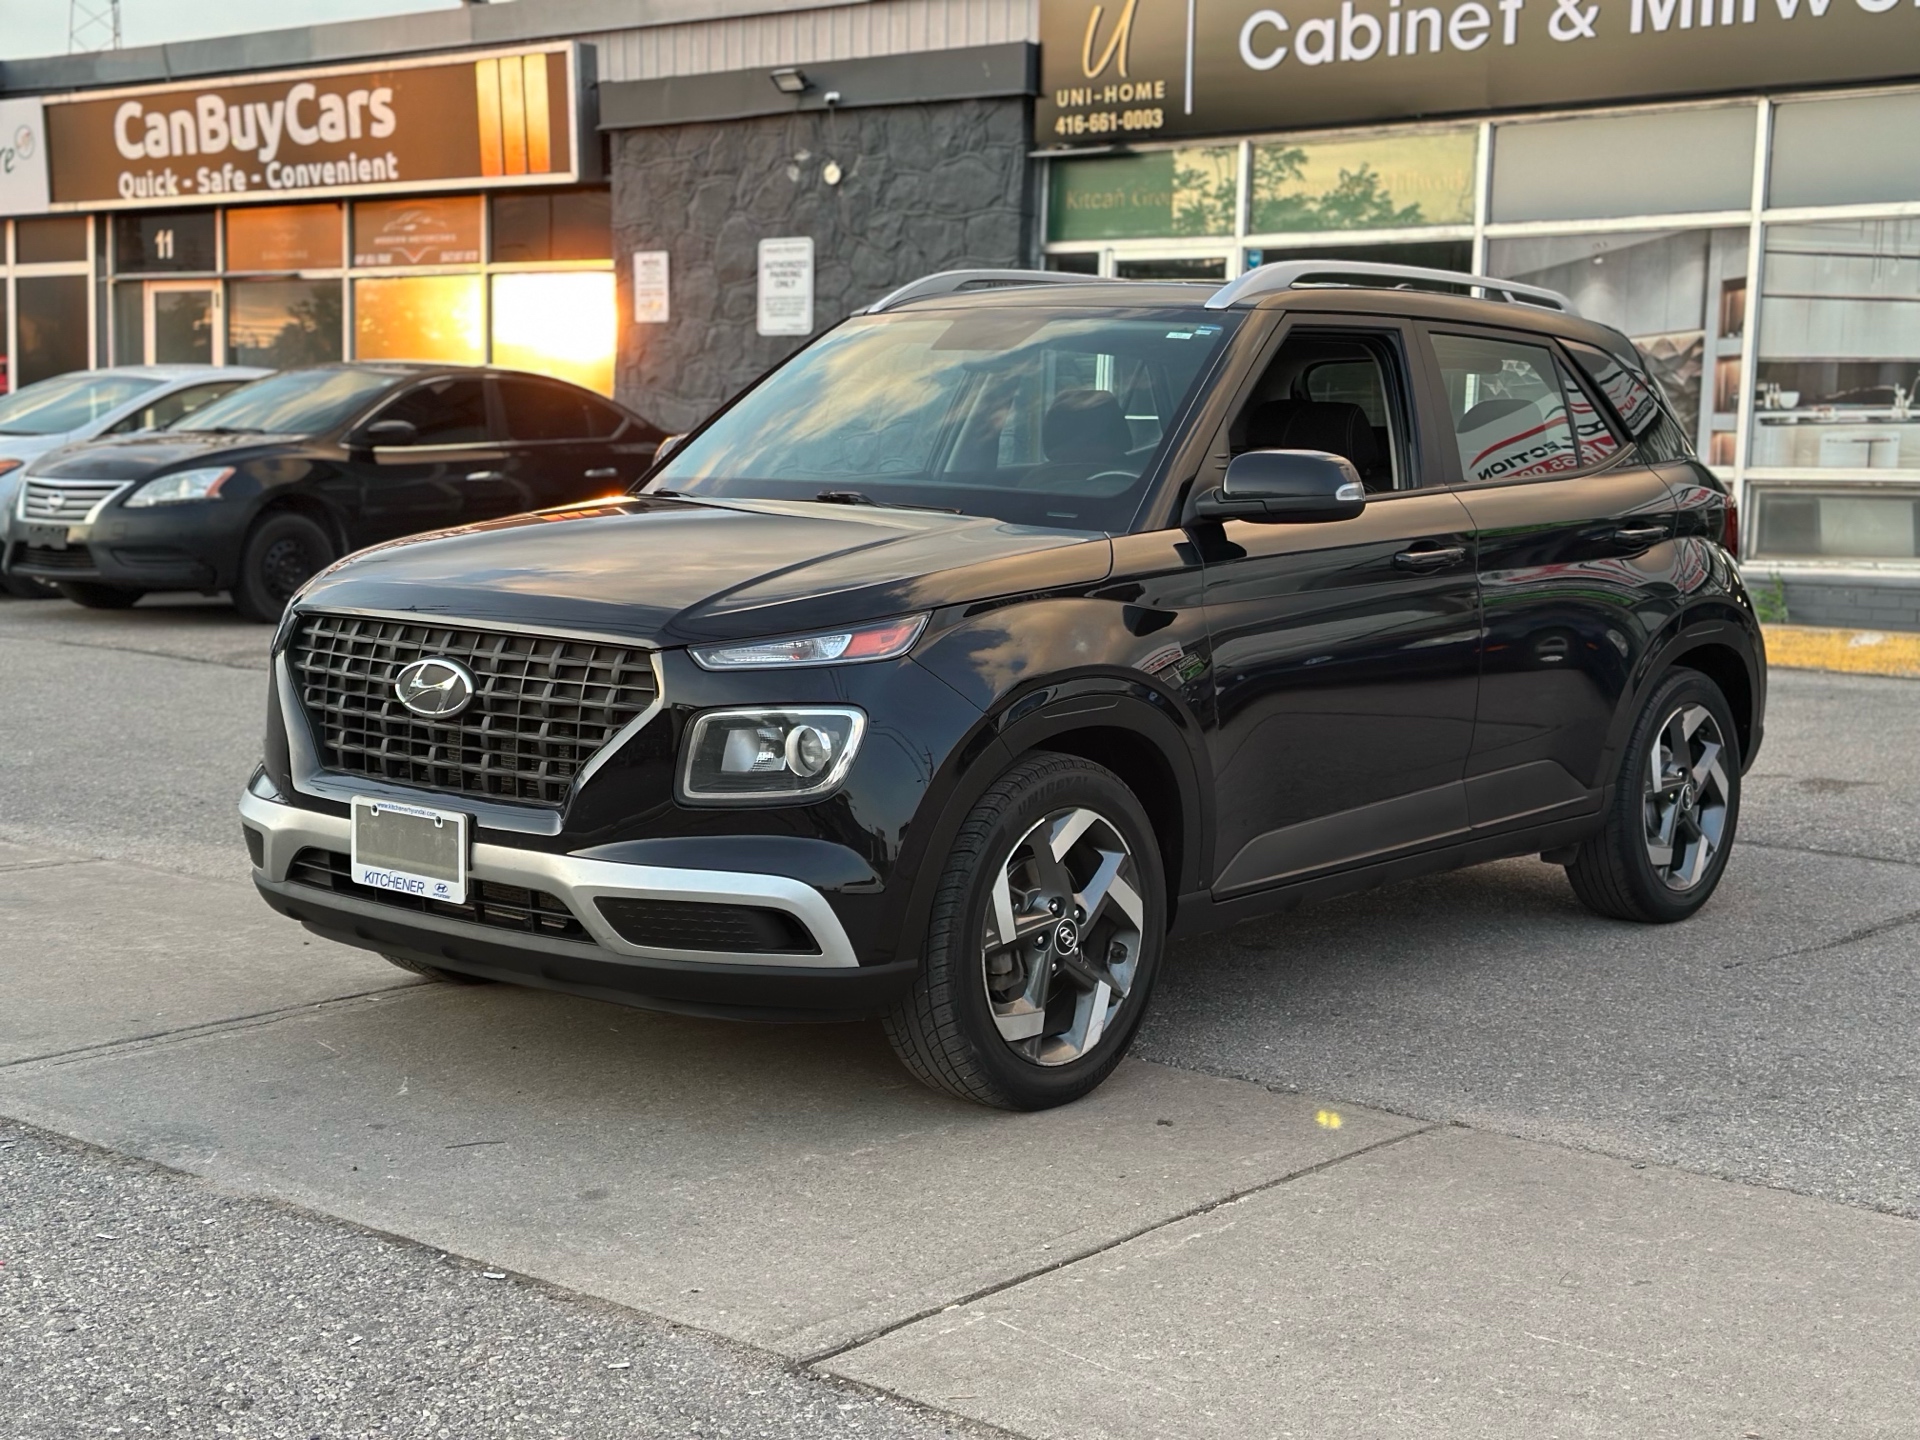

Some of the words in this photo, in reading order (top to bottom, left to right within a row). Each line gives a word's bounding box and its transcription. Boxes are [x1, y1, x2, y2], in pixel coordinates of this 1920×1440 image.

[1239, 0, 1523, 71] Cabinet
[1548, 0, 1600, 41] &
[1056, 80, 1165, 108] UNI-HOME
[114, 82, 397, 163] CanBuyCars
[1054, 107, 1164, 135] 416-661-0003
[118, 167, 180, 199] Quick
[196, 162, 247, 194] Safe
[266, 151, 399, 190] Convenient
[154, 229, 174, 260] 11
[363, 870, 425, 895] KITCHENER
